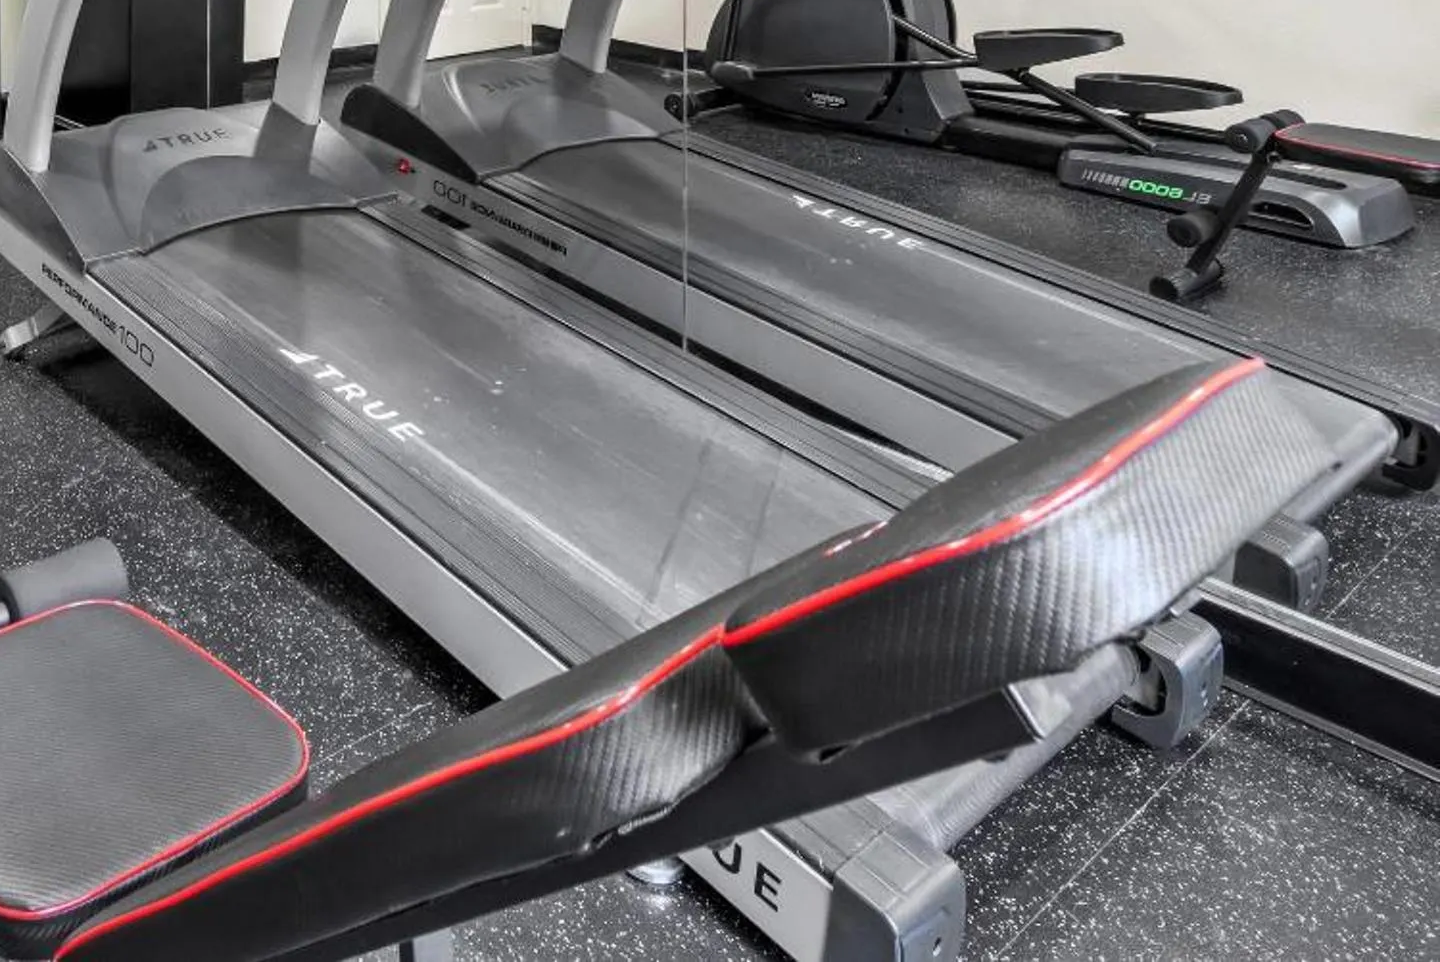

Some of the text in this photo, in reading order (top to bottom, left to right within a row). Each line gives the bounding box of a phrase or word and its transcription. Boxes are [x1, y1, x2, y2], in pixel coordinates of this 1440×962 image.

[157, 128, 231, 148] TRUE
[42, 263, 154, 367] PERFORMANCE 100
[315, 364, 424, 442] TRUE
[712, 843, 782, 913] UE
